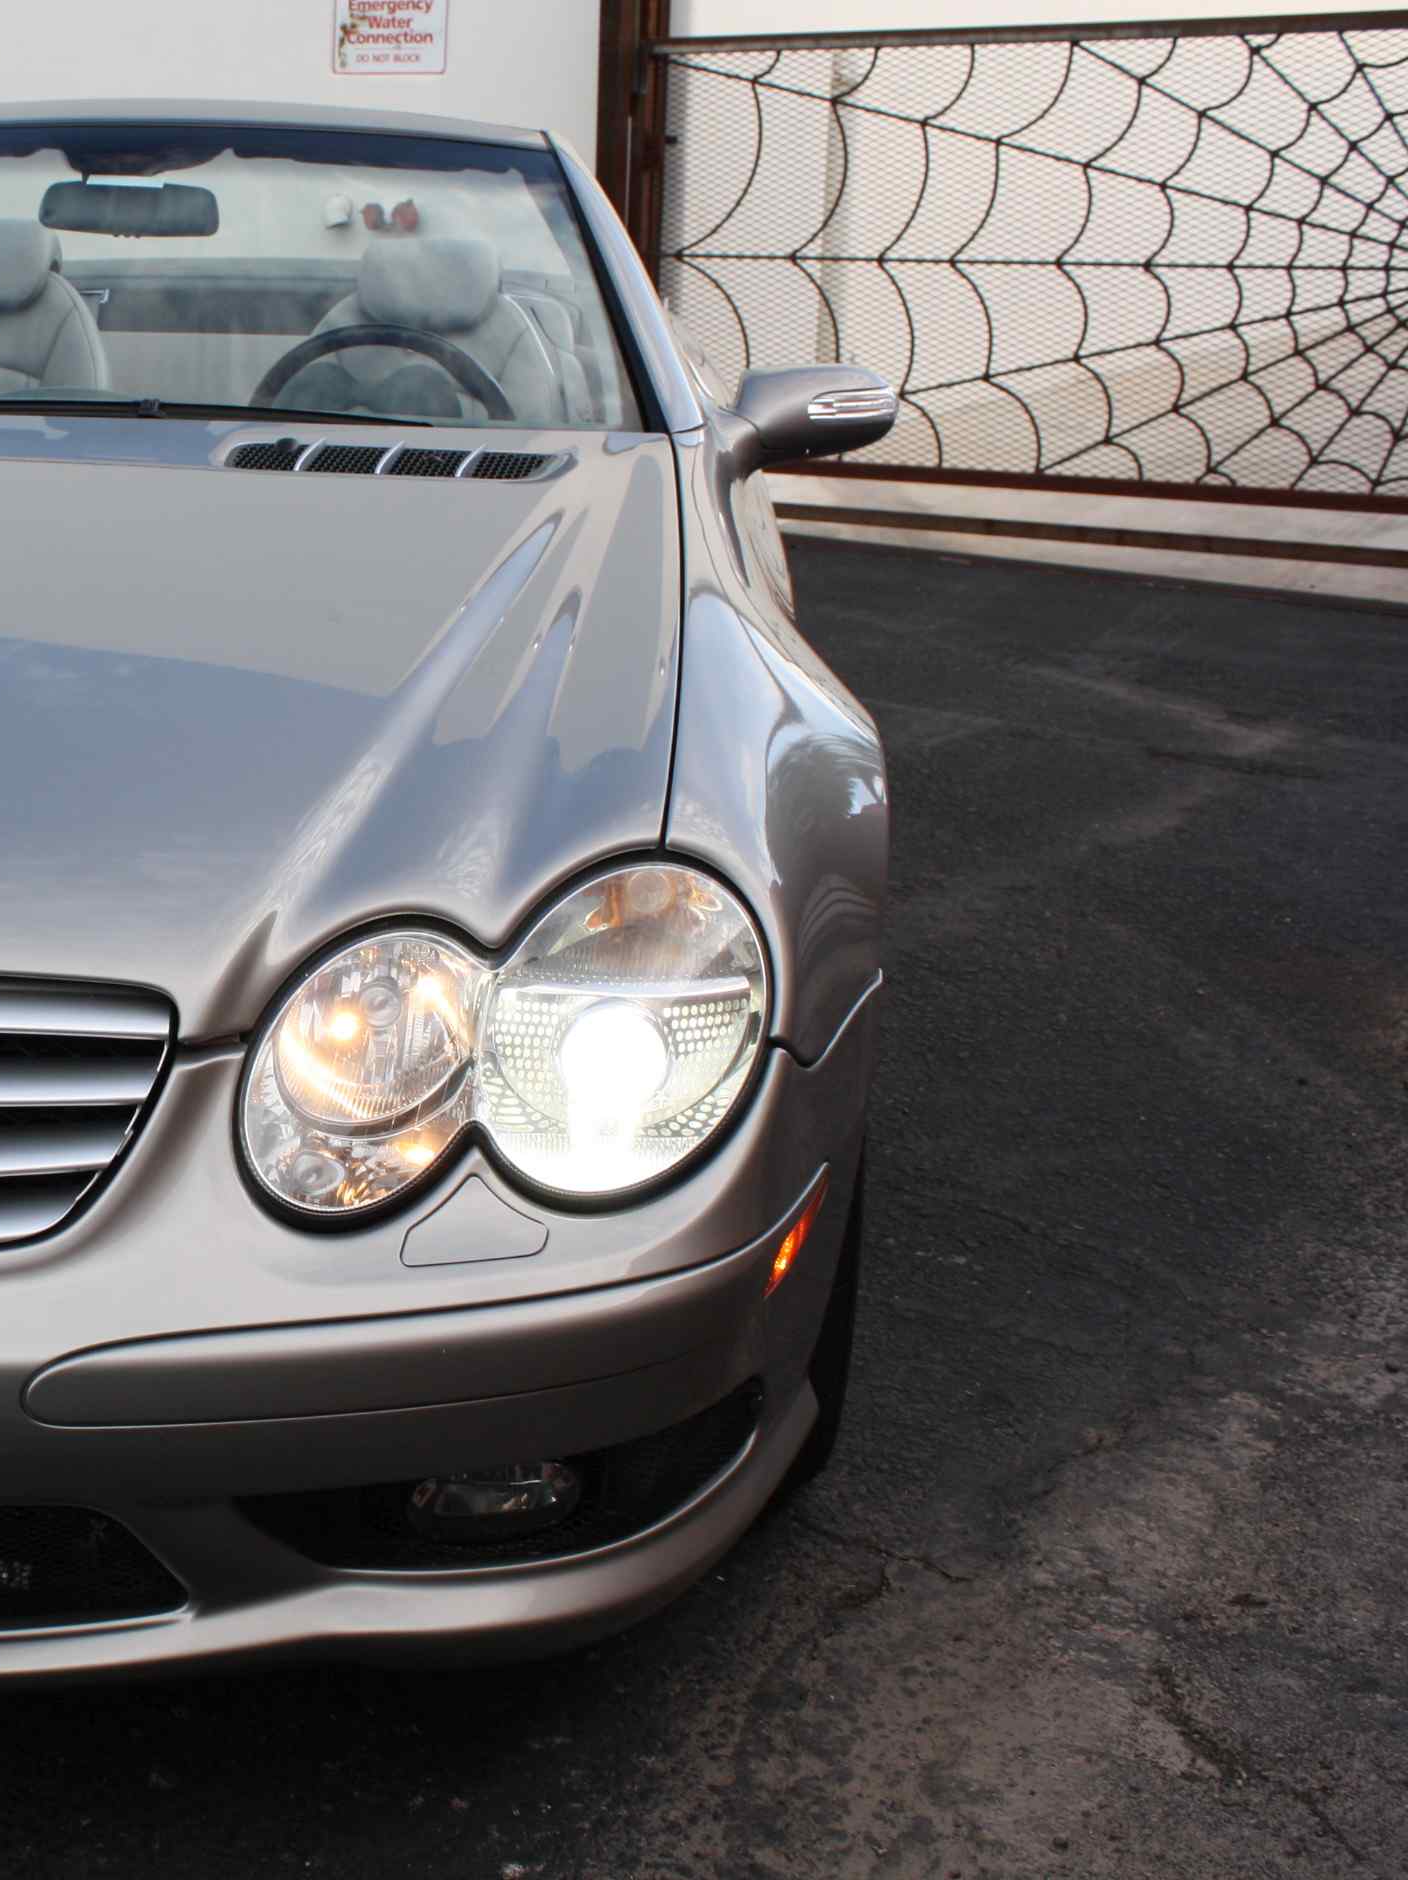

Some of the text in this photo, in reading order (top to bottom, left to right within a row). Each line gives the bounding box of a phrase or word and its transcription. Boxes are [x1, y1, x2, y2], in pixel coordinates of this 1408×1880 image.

[349, 0, 433, 13] Emergency
[367, 16, 412, 28] Water
[346, 31, 433, 44] Connection
[372, 53, 390, 63] NOT
[394, 53, 420, 63] BLOCK
